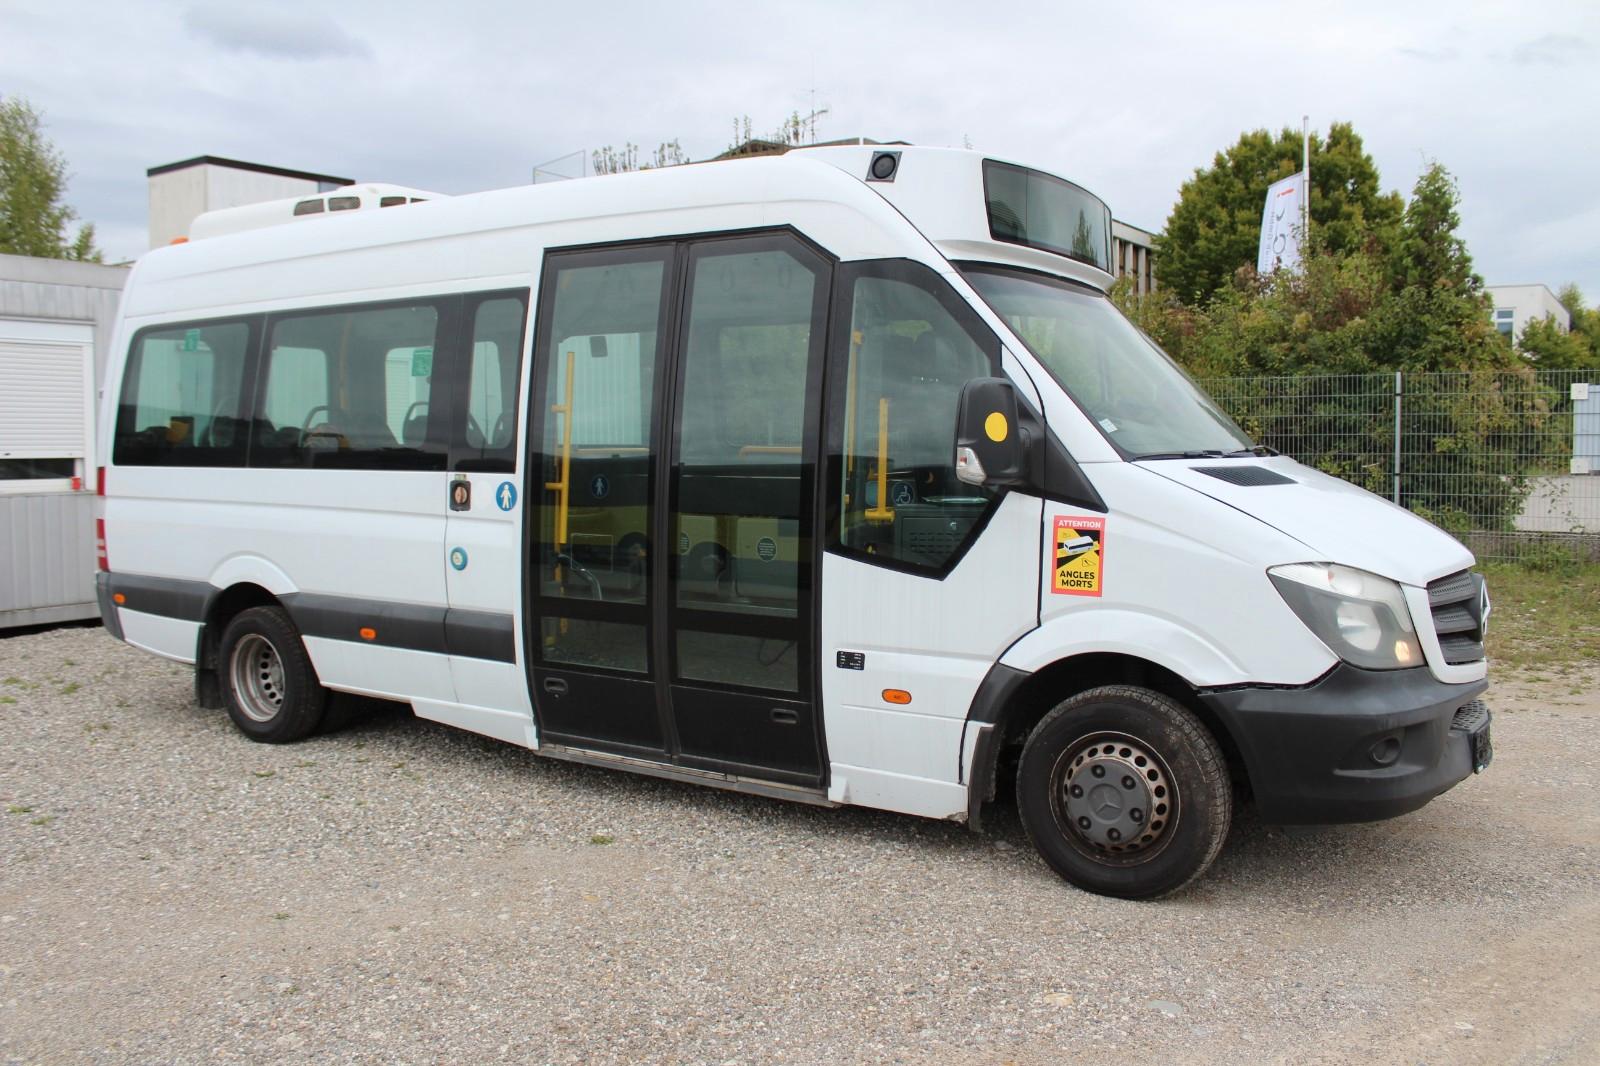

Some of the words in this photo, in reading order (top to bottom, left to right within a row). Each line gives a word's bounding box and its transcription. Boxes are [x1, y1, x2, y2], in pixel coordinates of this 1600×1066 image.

[1058, 520, 1101, 529] ATTENTION
[1060, 570, 1095, 580] ANGLES
[1061, 579, 1093, 588] MORTS
